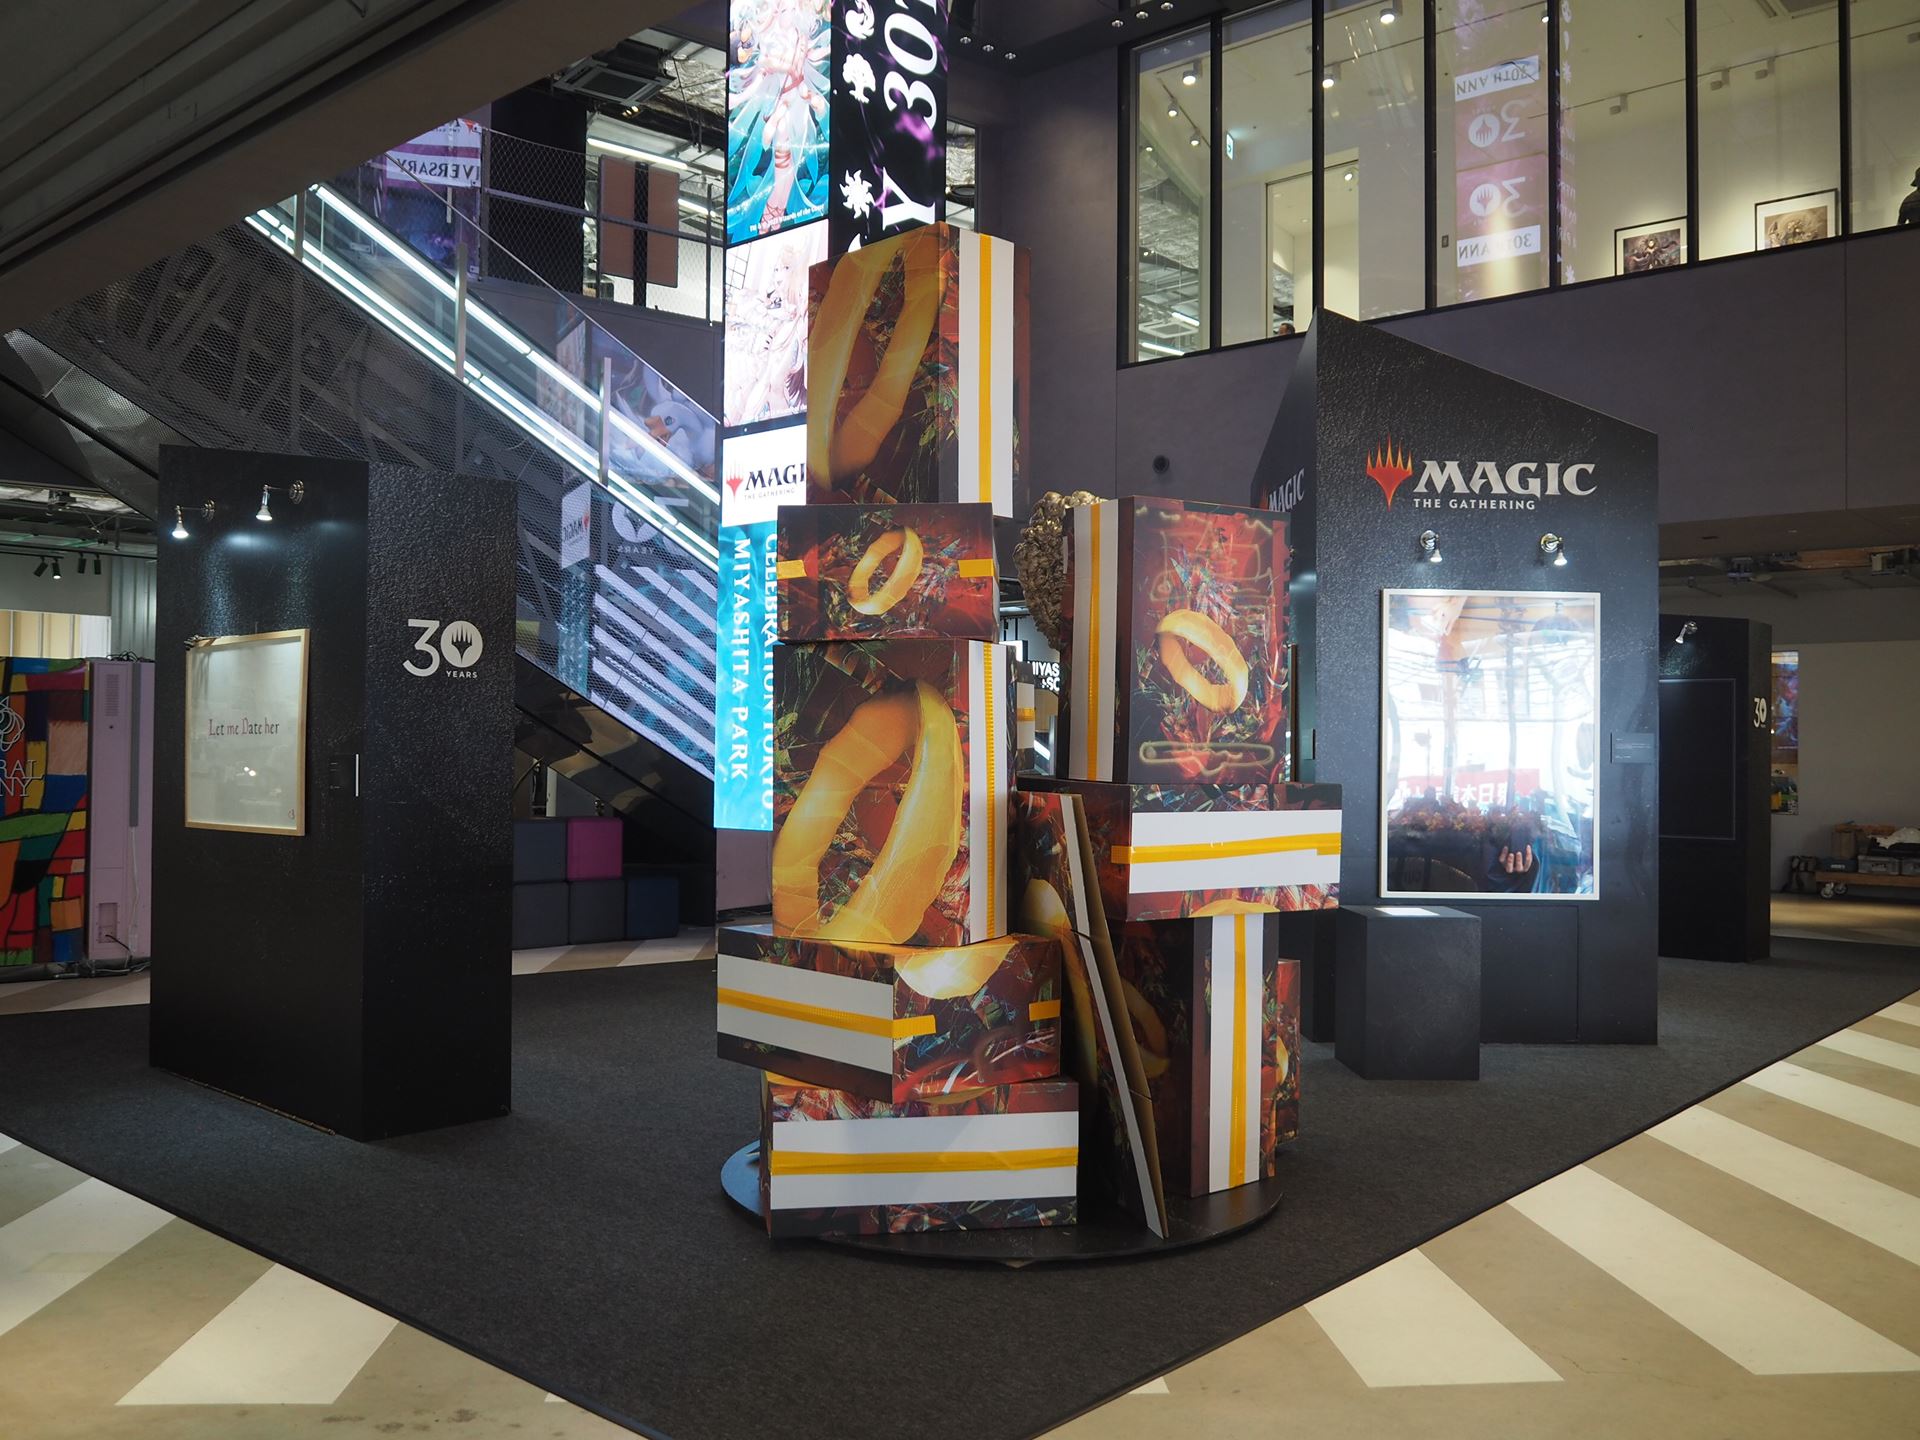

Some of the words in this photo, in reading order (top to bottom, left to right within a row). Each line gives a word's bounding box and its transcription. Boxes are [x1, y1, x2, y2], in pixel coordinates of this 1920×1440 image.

[758, 487, 796, 499] GATHERING
[1268, 467, 1305, 512] MAGIC
[1412, 459, 1599, 501] MAGIC
[1413, 498, 1442, 509] THE
[1448, 498, 1537, 511] GATHERING
[732, 538, 751, 694] MIYASHITA
[402, 618, 484, 677] 30
[445, 670, 479, 680] YEARS
[1032, 661, 1060, 677] IYAS
[208, 719, 225, 737] Let
[226, 723, 240, 736] me
[241, 716, 264, 736] Date
[264, 716, 280, 735] her
[728, 706, 749, 780] PARK
